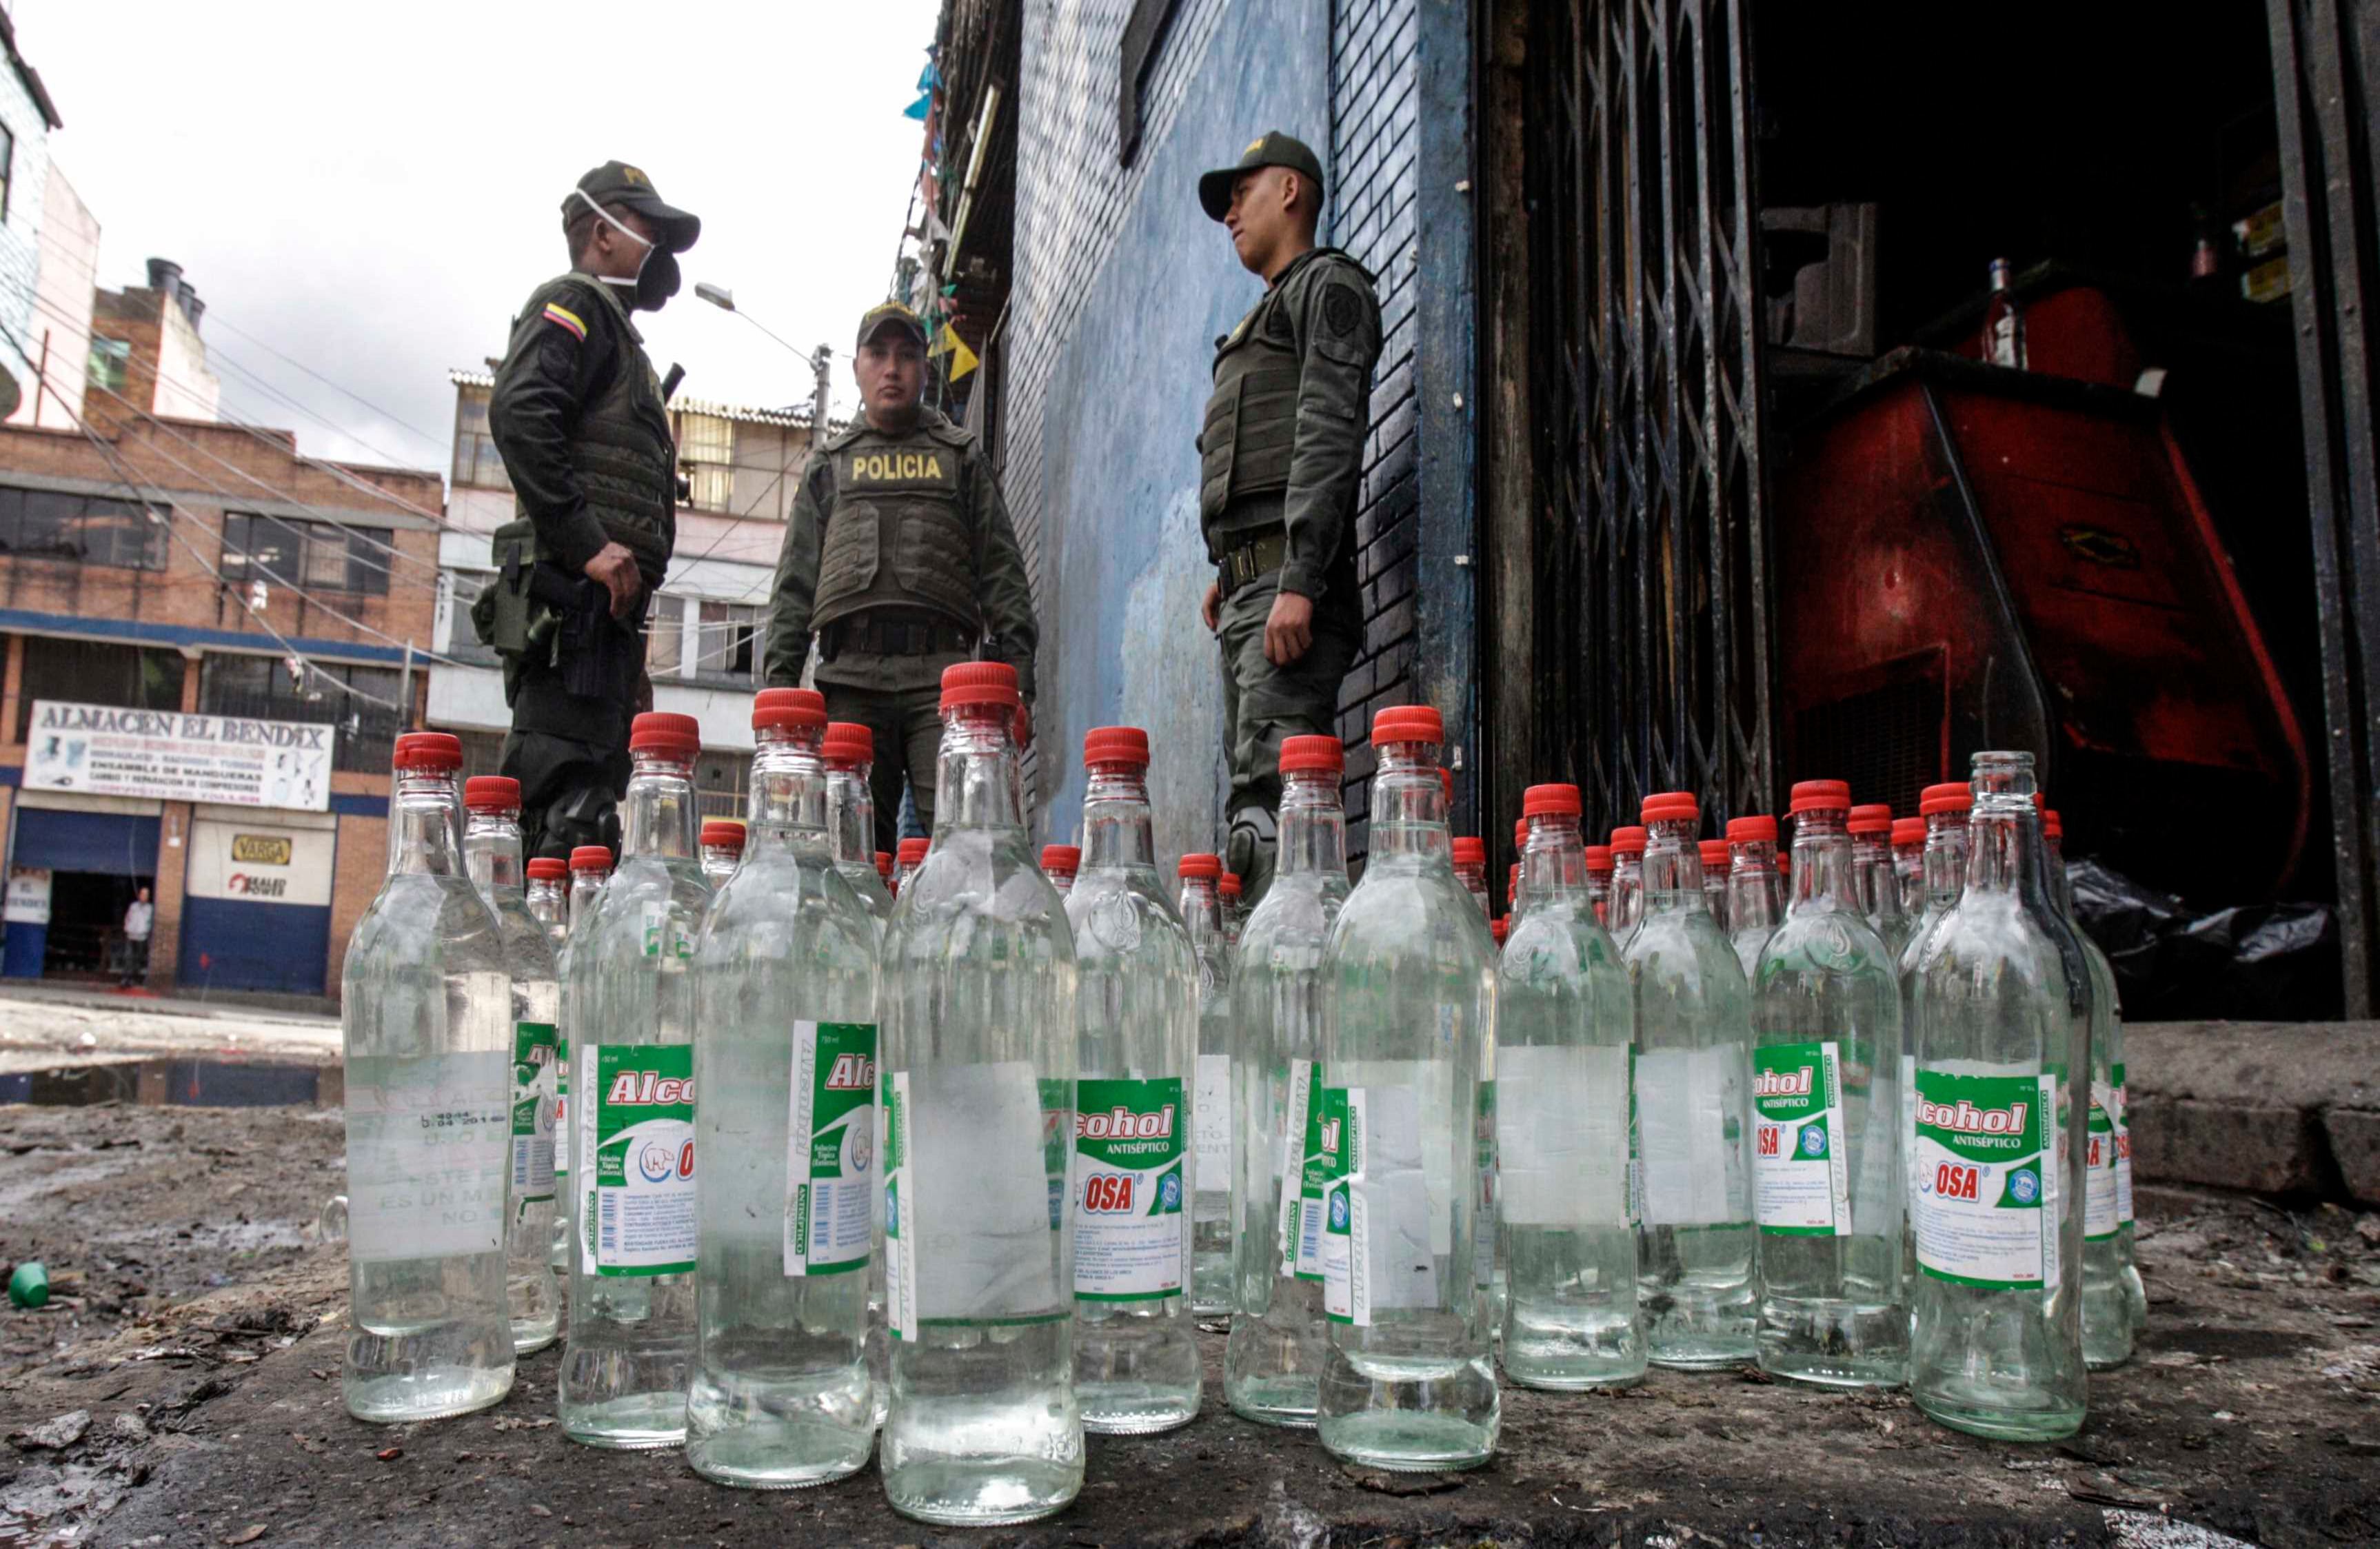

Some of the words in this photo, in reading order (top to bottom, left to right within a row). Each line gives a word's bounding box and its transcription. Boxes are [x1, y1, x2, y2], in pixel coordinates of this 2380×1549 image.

[852, 453, 942, 480] POLICIA
[41, 707, 174, 737] ALMACEN
[181, 716, 214, 740] EL
[221, 719, 324, 749] BENDIX
[90, 761, 158, 773] ENSAMBLE
[163, 767, 179, 776] DE
[183, 768, 263, 782] MANGUERAS
[240, 839, 285, 860] VARGA
[607, 1071, 695, 1105] Alco
[796, 1039, 814, 1157] Alcohol
[1754, 1066, 1813, 1097] ohol
[1763, 1097, 1809, 1108] ANTISÉPTICO
[1915, 1091, 2027, 1135] lcohol
[1077, 1104, 1174, 1140] cohol
[1107, 1140, 1169, 1155] ANTISÉPTICO
[1953, 1135, 2021, 1148] ANTISÉPTICO
[1085, 1175, 1133, 1211] OSA
[1935, 1163, 1979, 1199] OSA
[796, 1186, 806, 1253] ANTISÉPTICO
